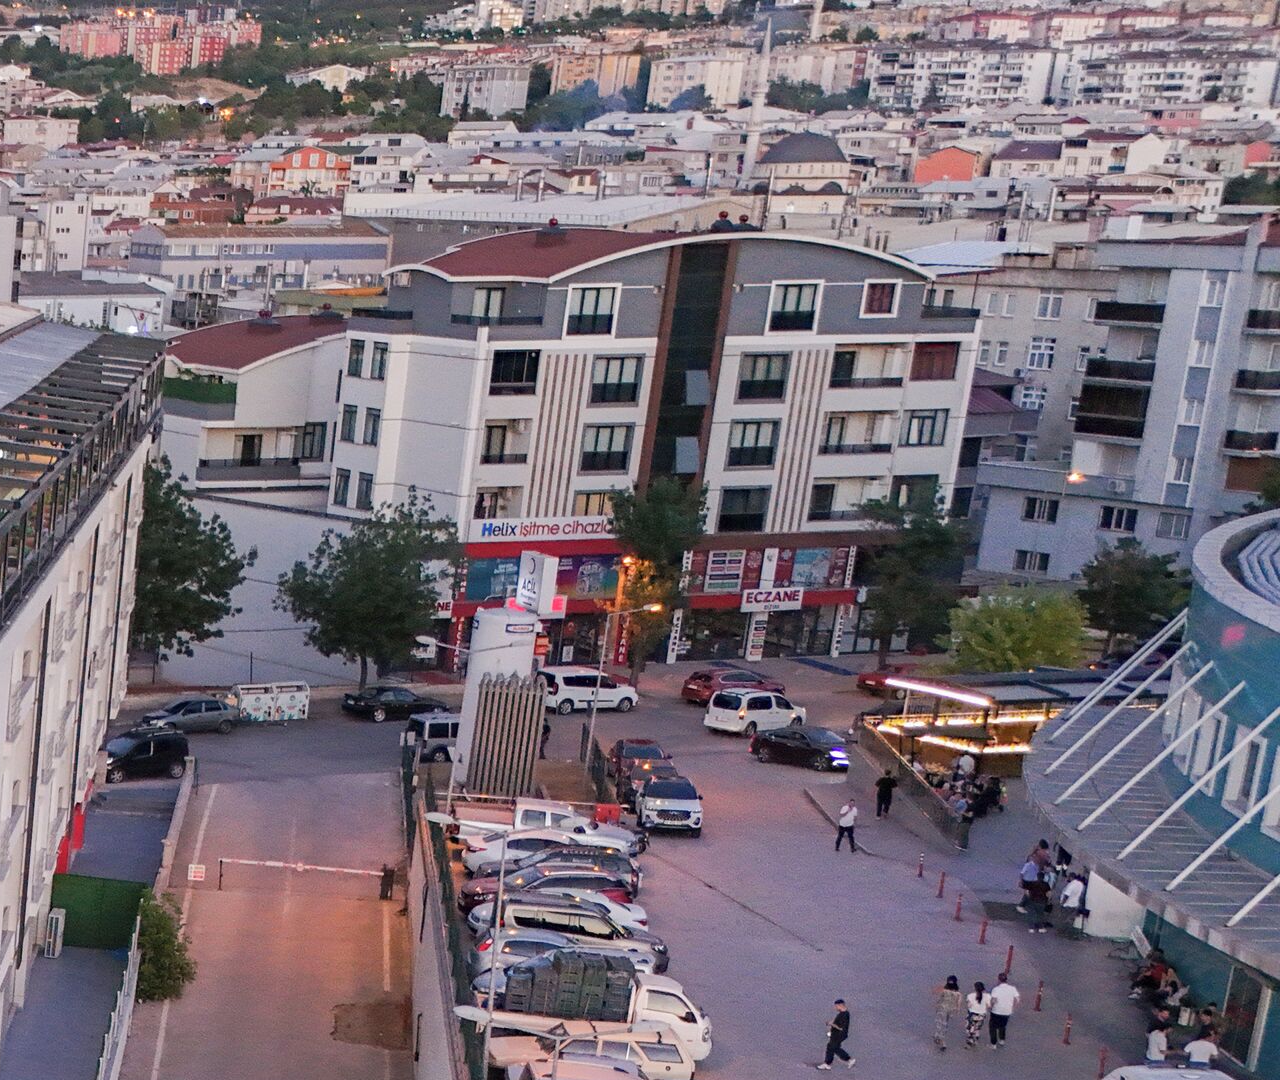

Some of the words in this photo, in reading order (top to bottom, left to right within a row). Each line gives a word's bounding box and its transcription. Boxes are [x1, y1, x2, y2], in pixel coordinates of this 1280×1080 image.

[481, 523, 518, 537] Helix
[520, 521, 560, 537] işitme
[746, 590, 800, 604] ECZANE
